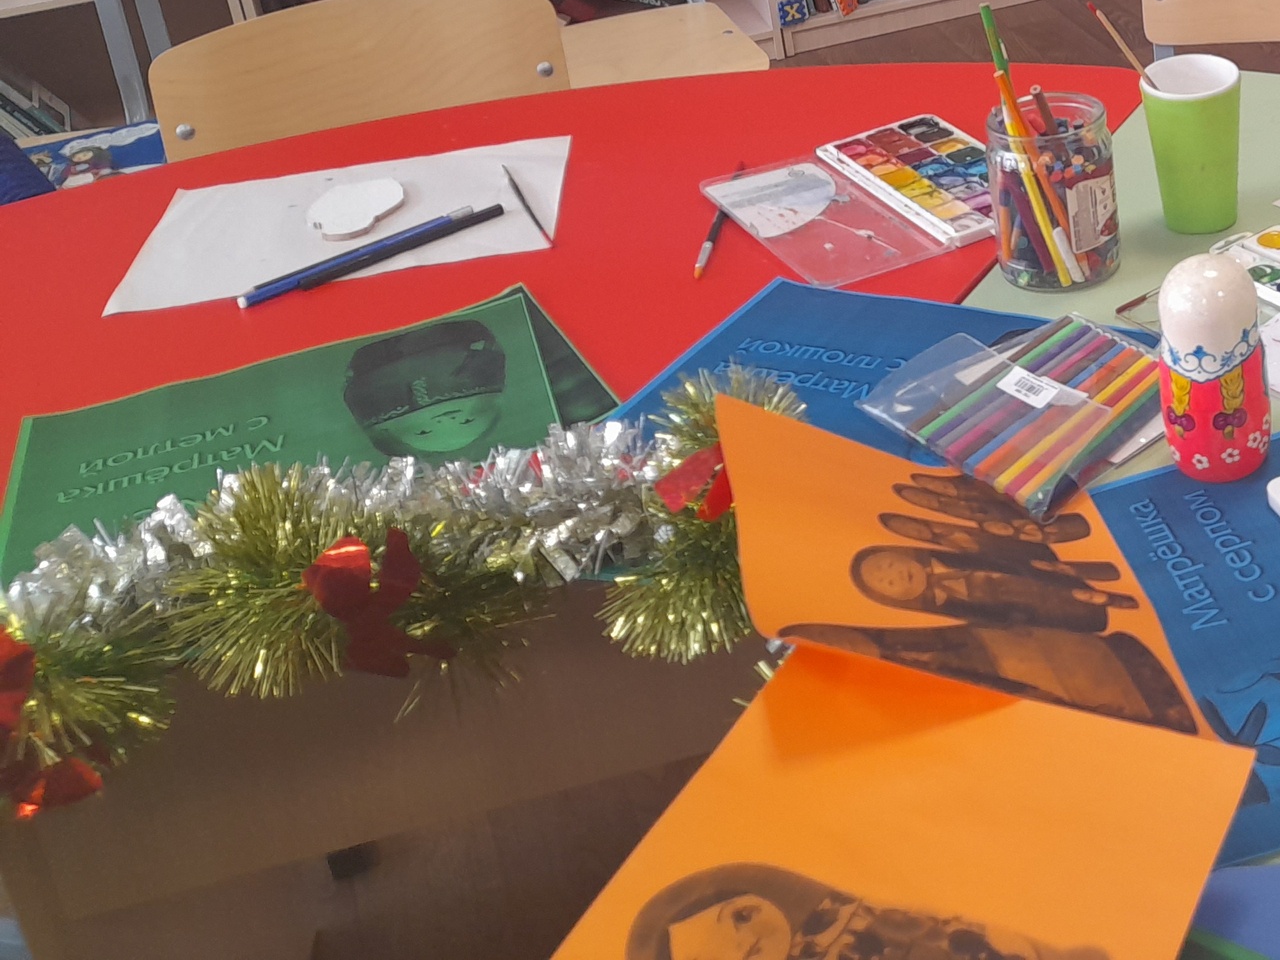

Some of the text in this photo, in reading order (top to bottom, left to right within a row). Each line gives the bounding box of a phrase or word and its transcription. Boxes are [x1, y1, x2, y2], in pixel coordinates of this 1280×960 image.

[784, 4, 802, 22] Х
[735, 337, 883, 371] плошкой
[56, 434, 286, 504] Матрёшка
[79, 423, 236, 478] метлой
[1129, 498, 1229, 631] Матрёшка
[1183, 489, 1262, 582] серпом
